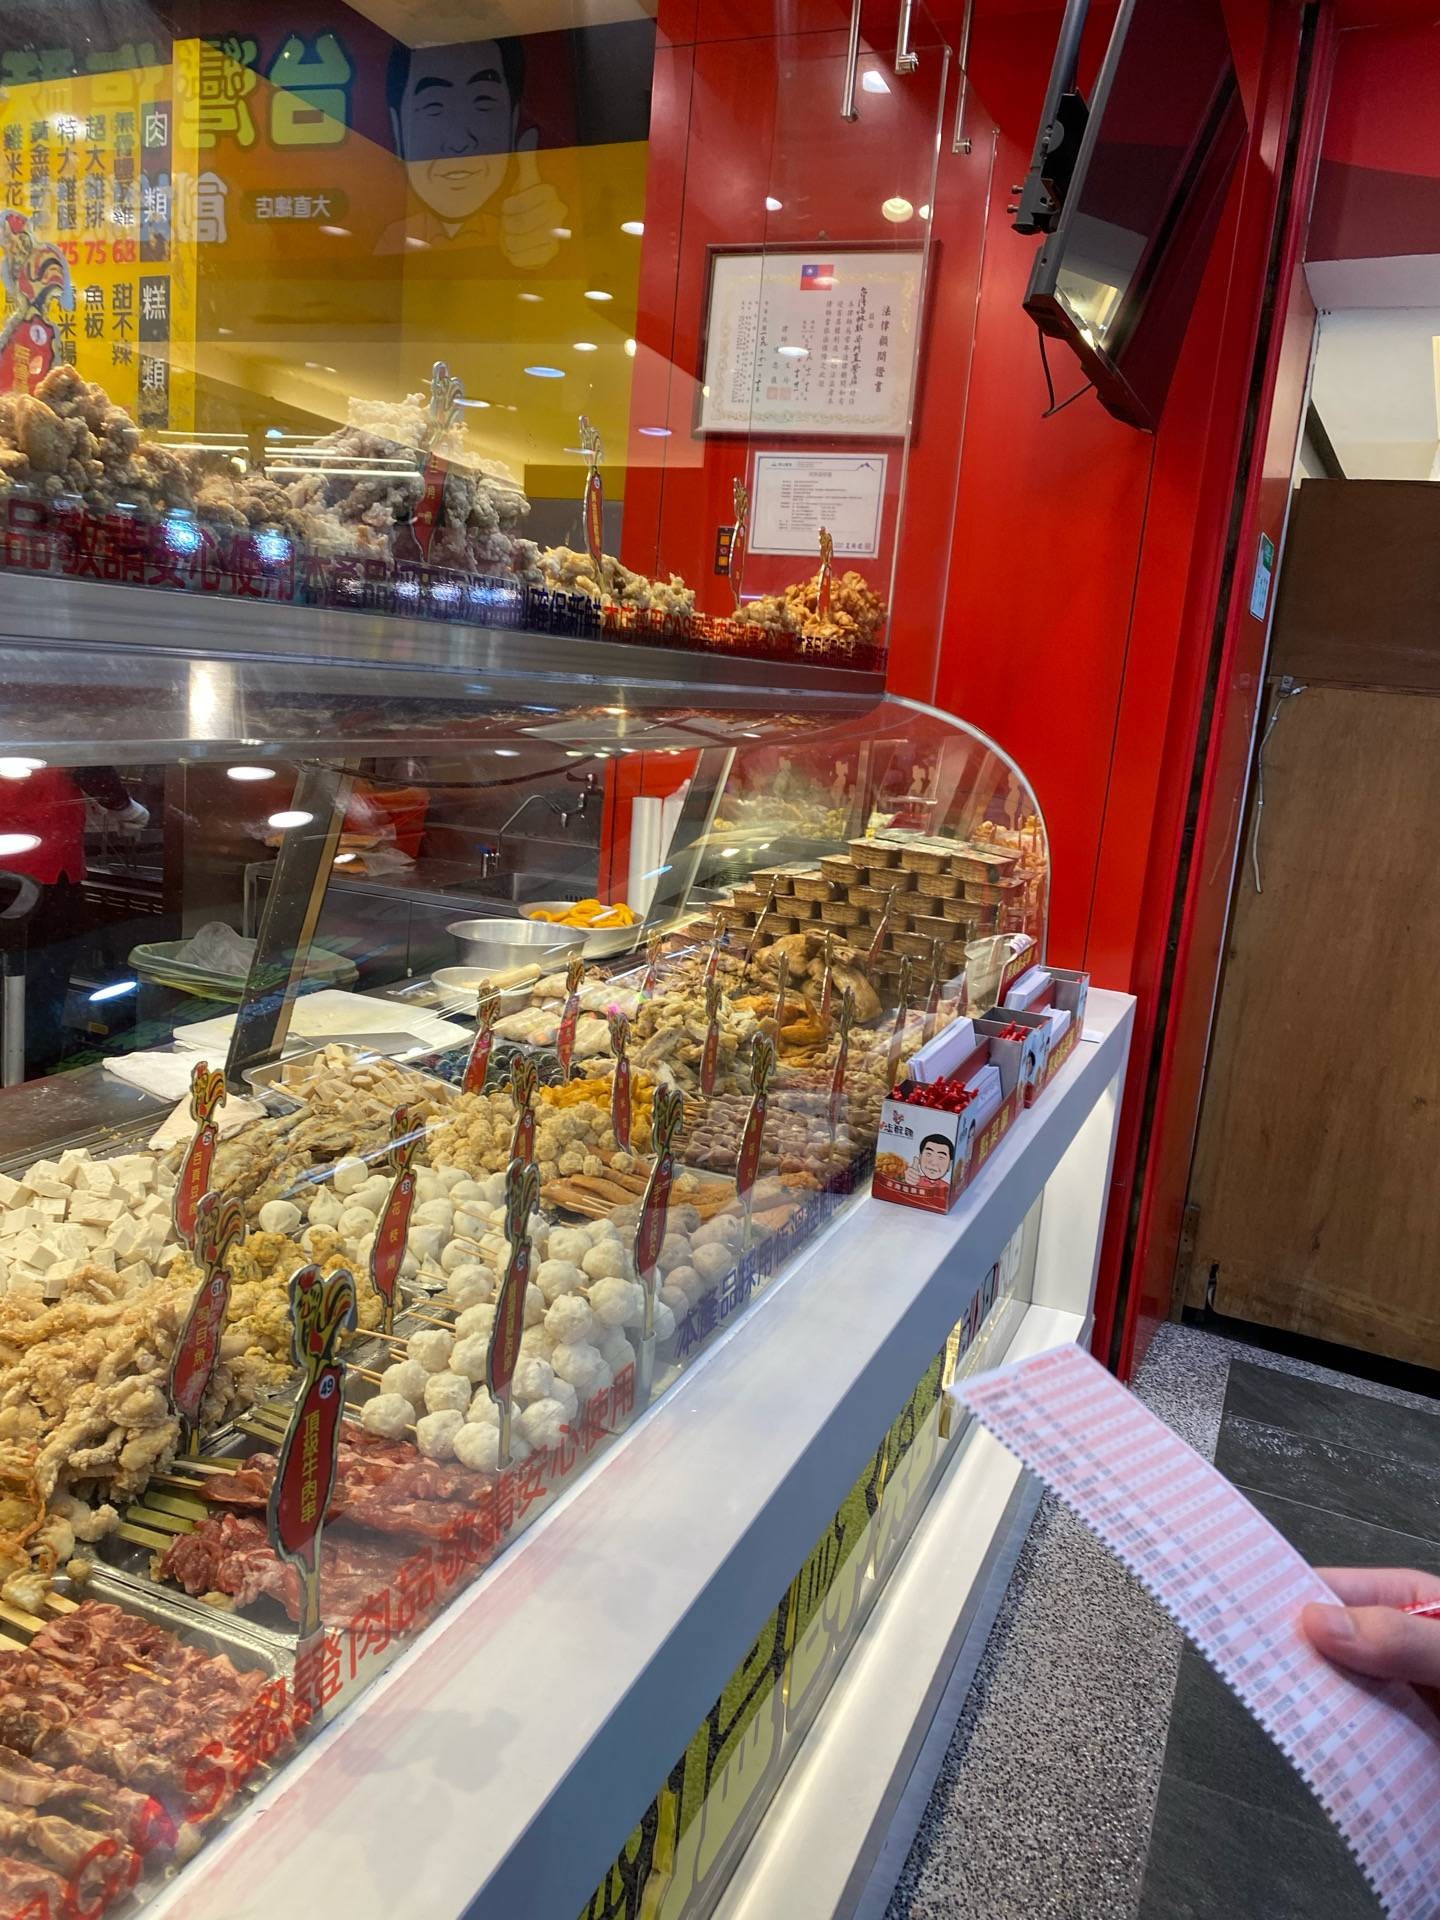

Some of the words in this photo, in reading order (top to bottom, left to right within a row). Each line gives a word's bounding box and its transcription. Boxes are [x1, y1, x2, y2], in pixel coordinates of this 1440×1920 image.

[4, 123, 22, 208] 雞米花
[84, 239, 107, 264] 75
[84, 284, 105, 339] 魚板
[112, 282, 133, 366] 甜不辣
[142, 285, 166, 392] 糕類
[320, 1377, 335, 1397] 49
[301, 1409, 321, 1524] 頂級牛肉串
